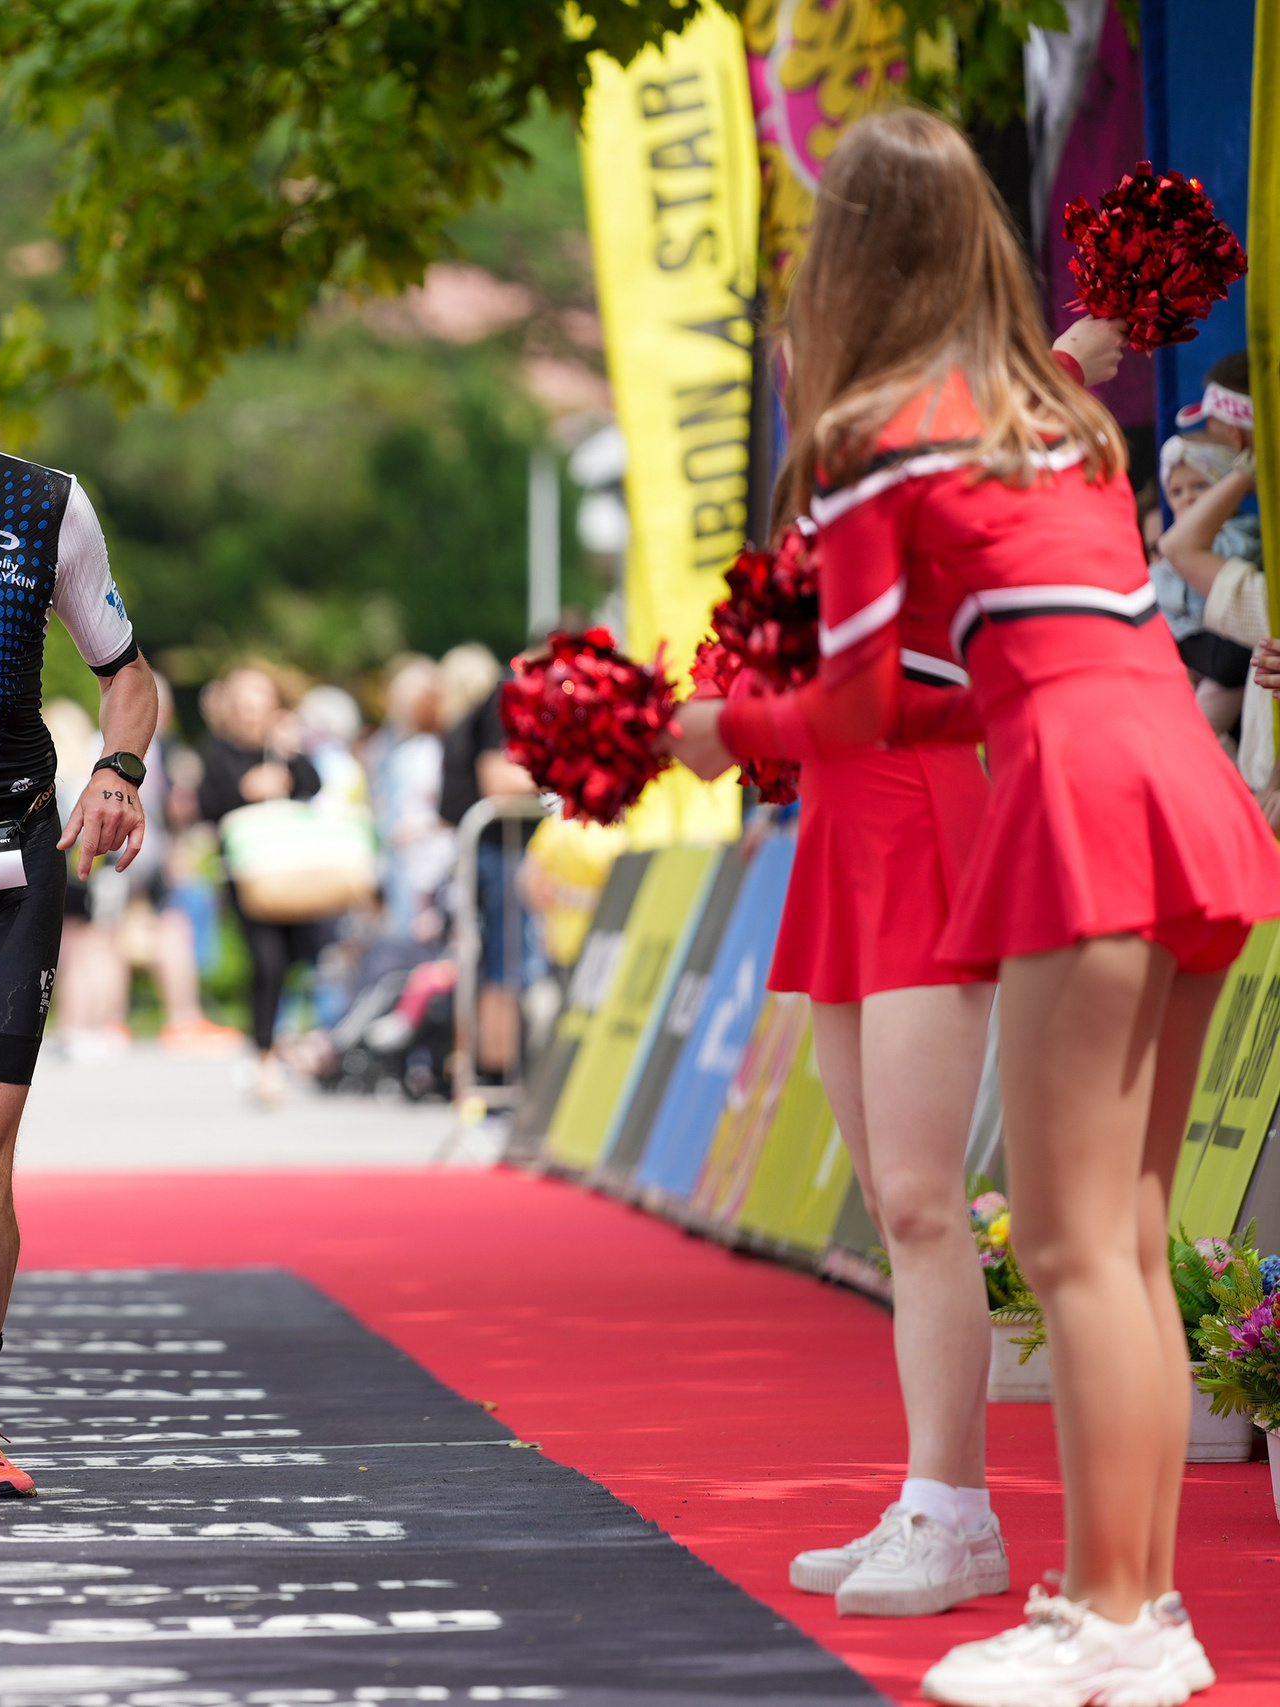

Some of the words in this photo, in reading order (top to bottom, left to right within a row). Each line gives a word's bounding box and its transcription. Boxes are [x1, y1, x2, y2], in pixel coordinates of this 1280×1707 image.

[640, 72, 718, 272] STAR
[102, 789, 134, 805] 164
[11, 1520, 408, 1538] STAR
[47, 1609, 504, 1637] STAR
